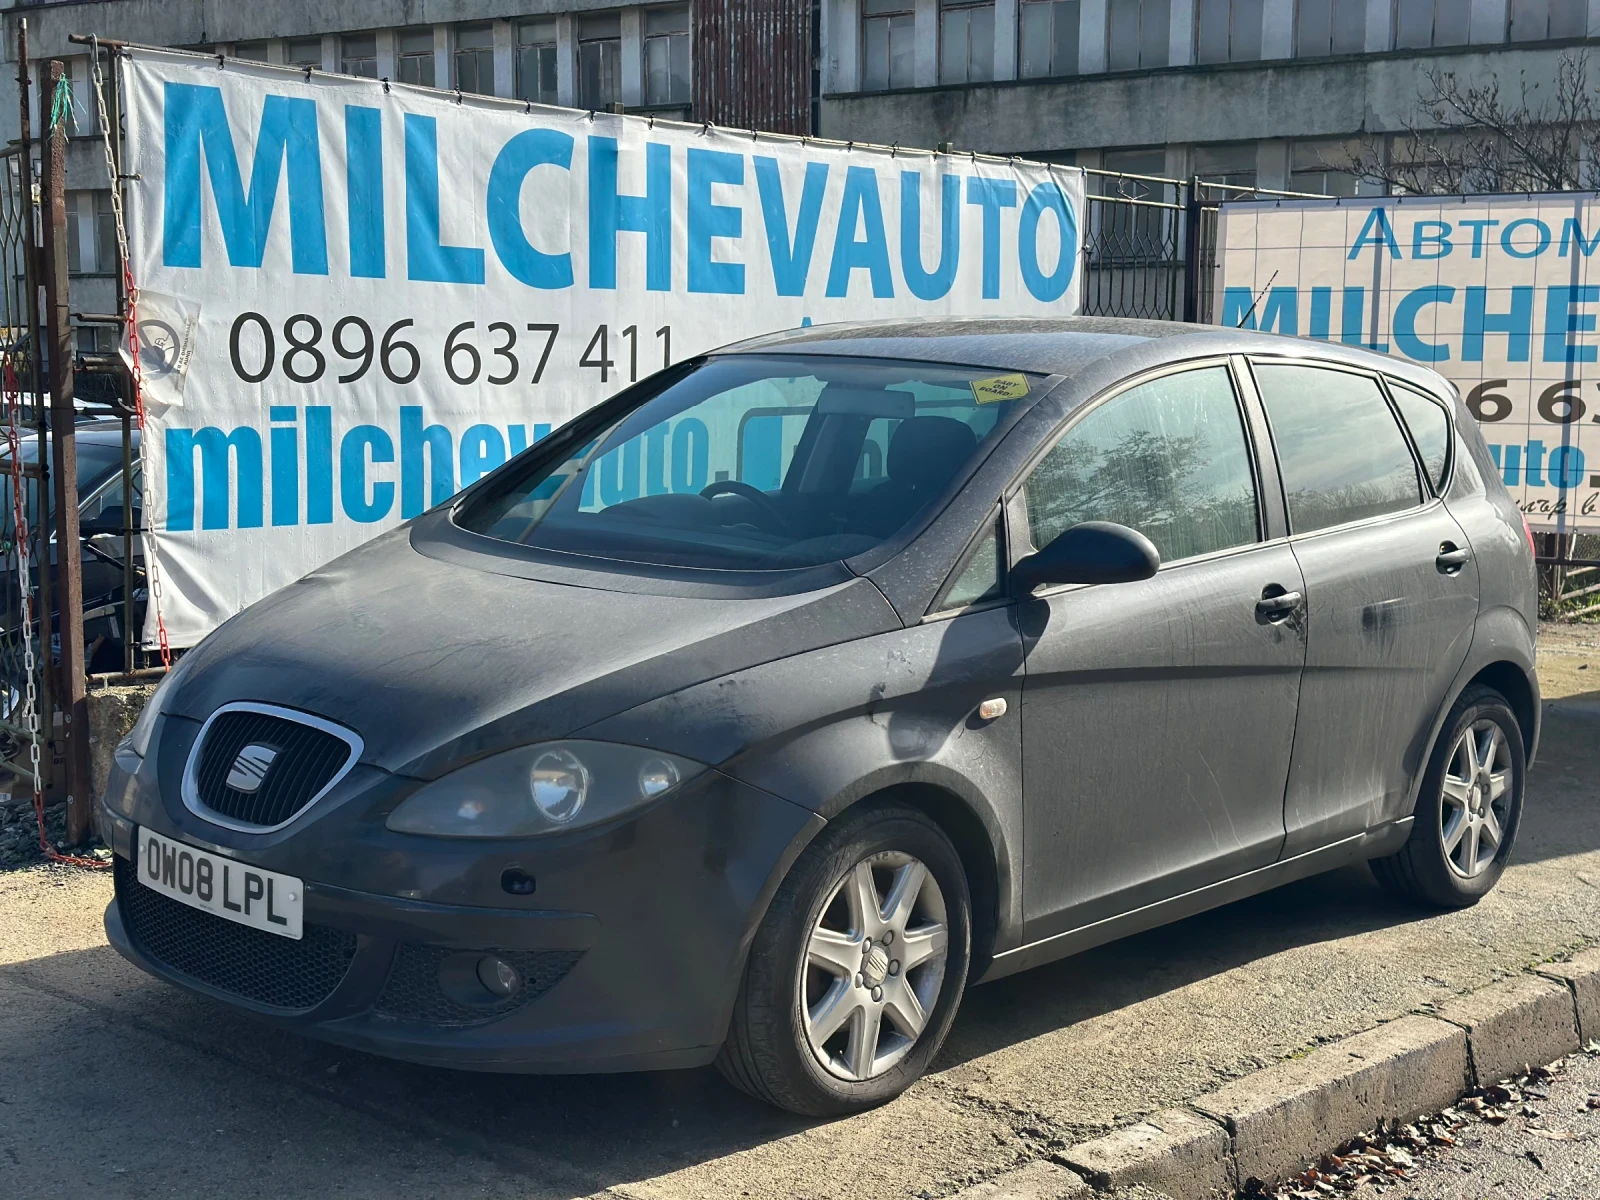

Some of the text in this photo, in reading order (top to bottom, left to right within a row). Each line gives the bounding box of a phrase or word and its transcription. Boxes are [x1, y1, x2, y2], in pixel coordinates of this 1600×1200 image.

[163, 81, 1076, 302] MILCHEVAUTO
[229, 312, 671, 386] 0896 637 411
[1537, 379, 1600, 424] 6
[148, 837, 287, 926] OW08 LPL
